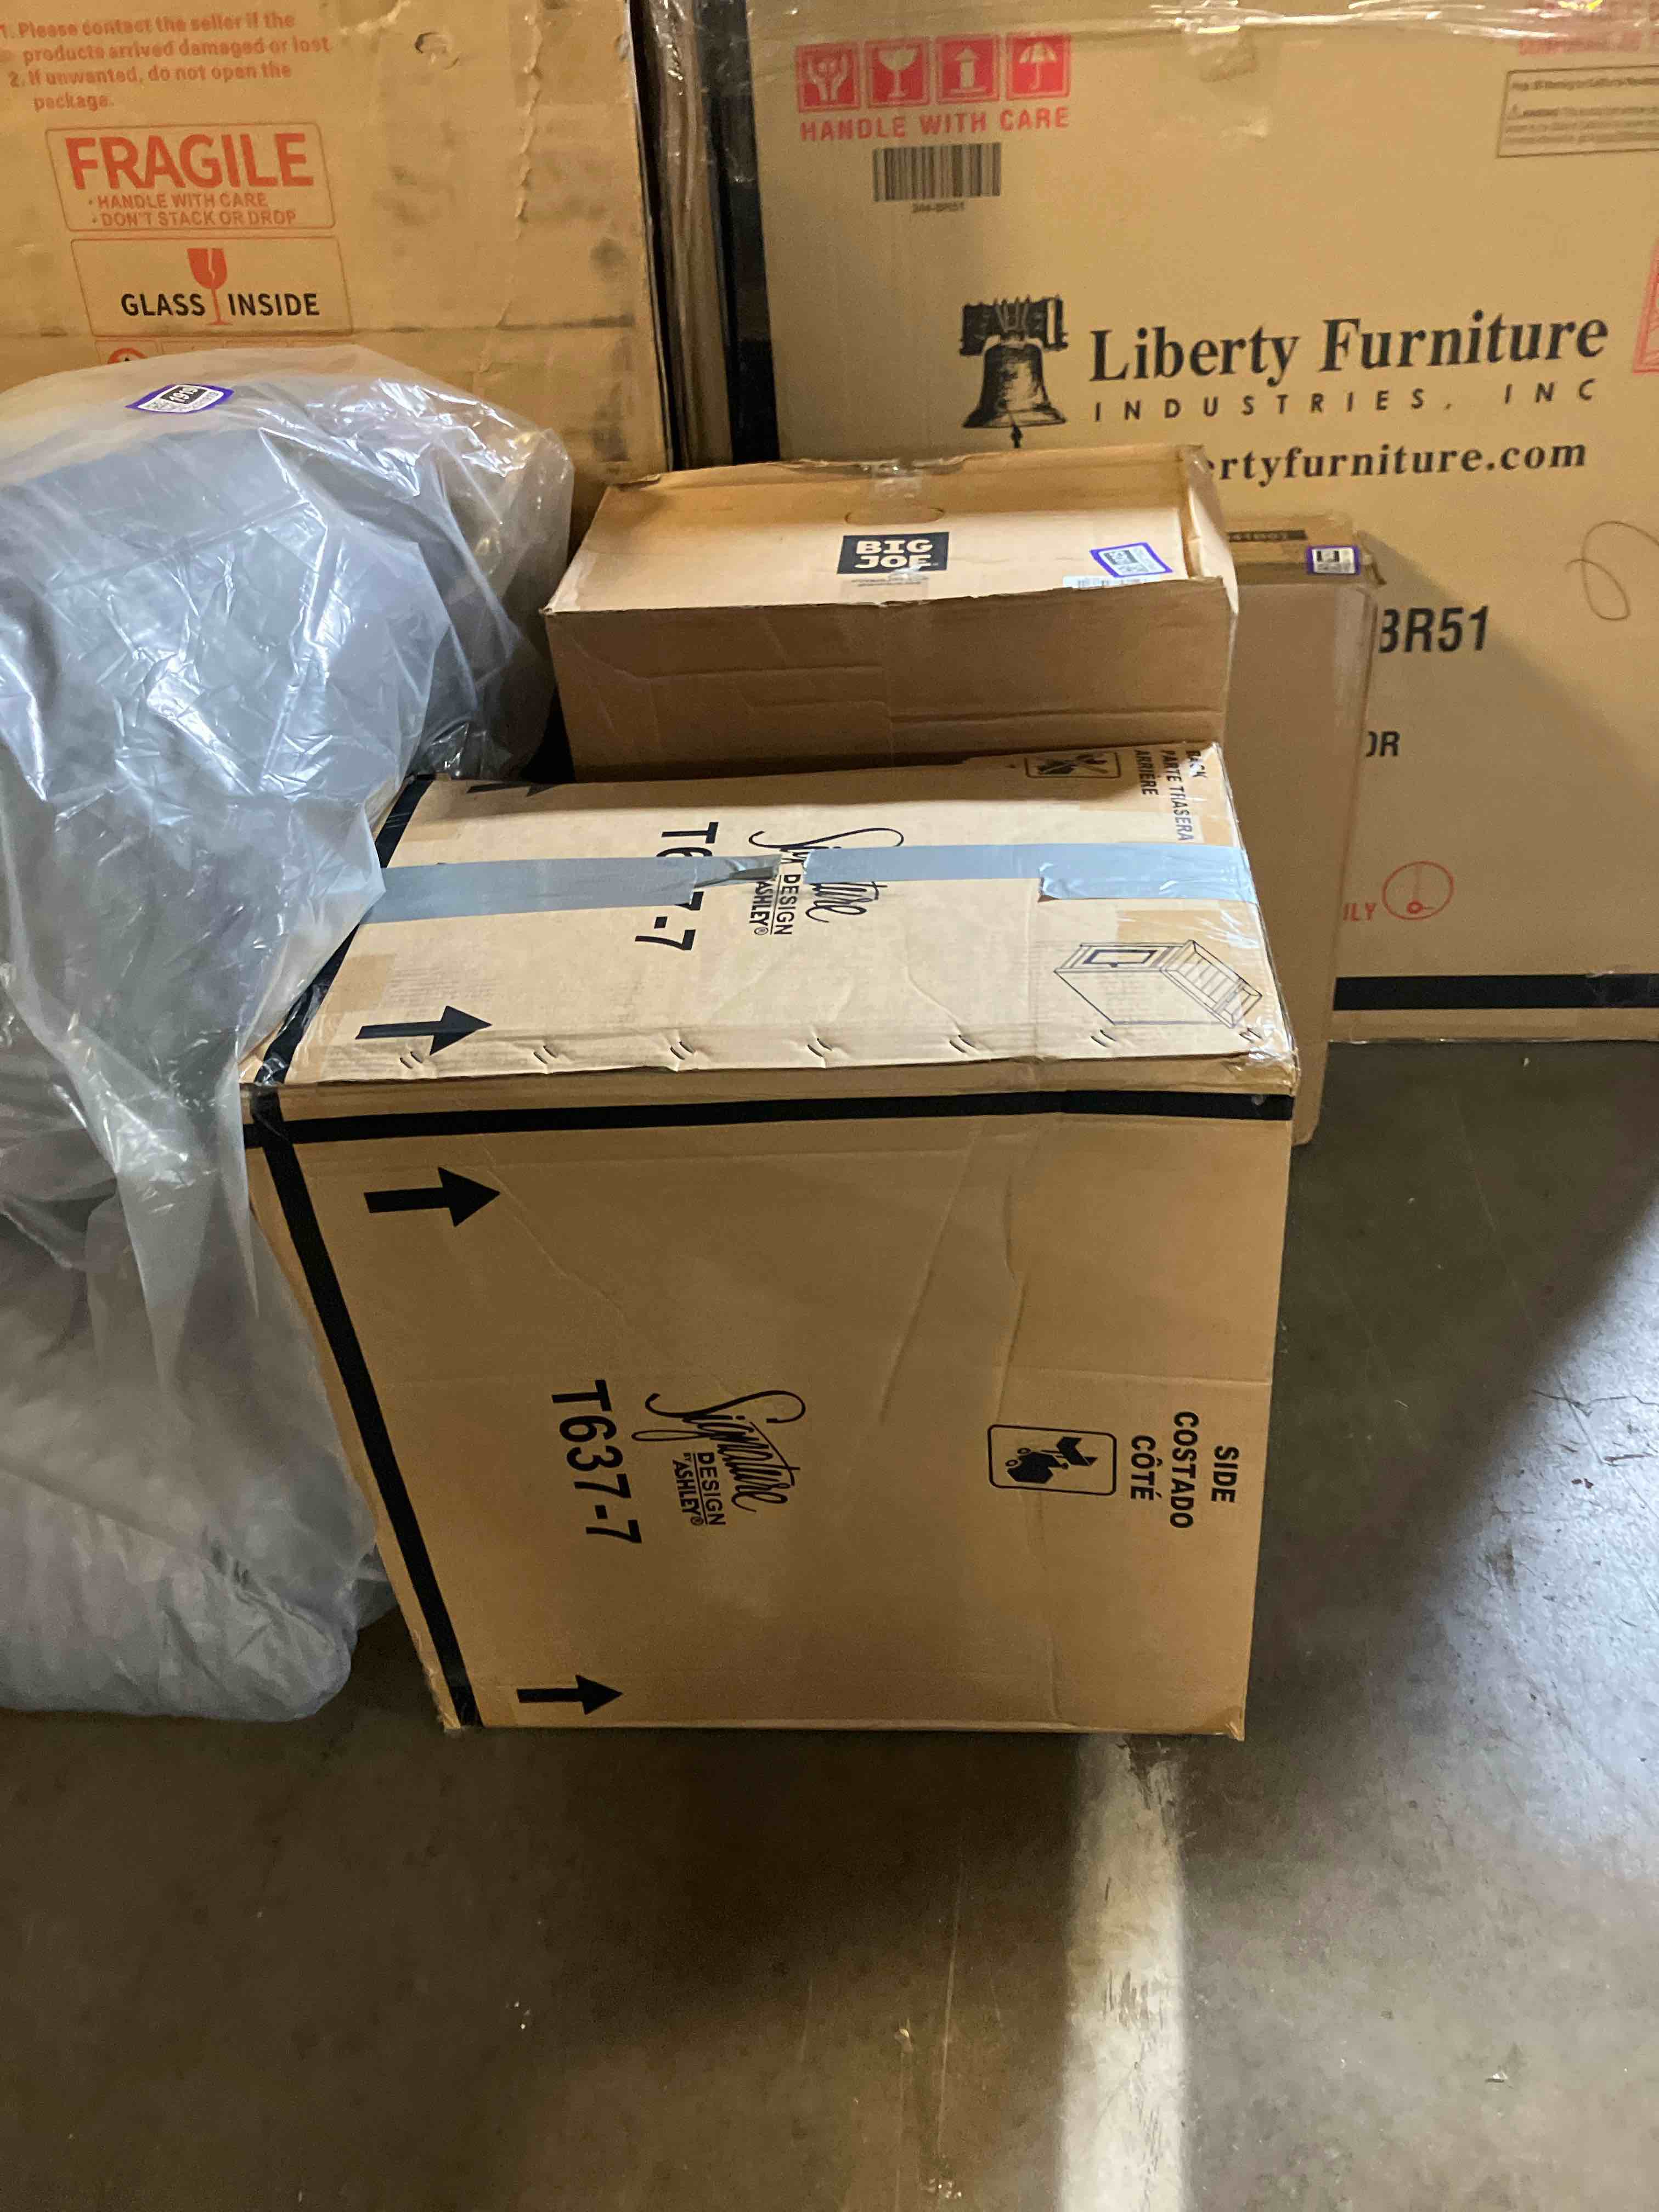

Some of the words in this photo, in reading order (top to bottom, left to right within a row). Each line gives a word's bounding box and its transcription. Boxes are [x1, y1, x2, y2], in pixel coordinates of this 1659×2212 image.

[18, 21, 77, 38] Please
[82, 20, 152, 36] contact
[155, 16, 186, 32] the
[190, 13, 241, 31] seller
[246, 11, 259, 28] if
[263, 11, 295, 28] the
[23, 44, 105, 66] products
[109, 41, 176, 59] arrived
[179, 37, 264, 58] damaged
[269, 40, 287, 53] or
[292, 35, 332, 53] lost
[8, 71, 26, 88] 2.
[29, 69, 41, 86] If
[46, 66, 144, 85] unwanted,
[148, 64, 171, 81] do
[175, 64, 206, 81] not
[211, 65, 257, 83] open
[261, 61, 292, 79] the
[33, 92, 115, 113] package.
[800, 116, 906, 142] HANDLE
[919, 112, 987, 136] WITH
[1000, 107, 1070, 132] CARE
[65, 132, 314, 190] FRAGILE
[97, 193, 167, 209] HANDLE
[172, 193, 216, 208] WITH
[220, 192, 268, 207] CARE
[100, 212, 152, 227] DON'T
[158, 211, 216, 226] STACK
[222, 210, 241, 225] OR
[249, 210, 297, 225] DROP
[121, 293, 206, 317] GLASS
[228, 293, 320, 317] INSIDE
[1089, 325, 1301, 387] Liberty
[1318, 309, 1609, 373] Furniture
[1504, 378, 1596, 405] INC
[854, 554, 932, 569] JOE
[856, 539, 933, 555] BIG
[1160, 749, 1182, 783] PARTE
[774, 874, 802, 935] DESIGN
[551, 1379, 642, 1544] T637-7
[631, 1390, 806, 1513] Signature
[683, 1452, 692, 1463] BY
[1130, 1434, 1163, 1502] CÔTÉ
[1169, 1410, 1199, 1529] COSTADO
[1210, 1444, 1239, 1503] SIDE
[697, 1452, 726, 1526] DESIGN
